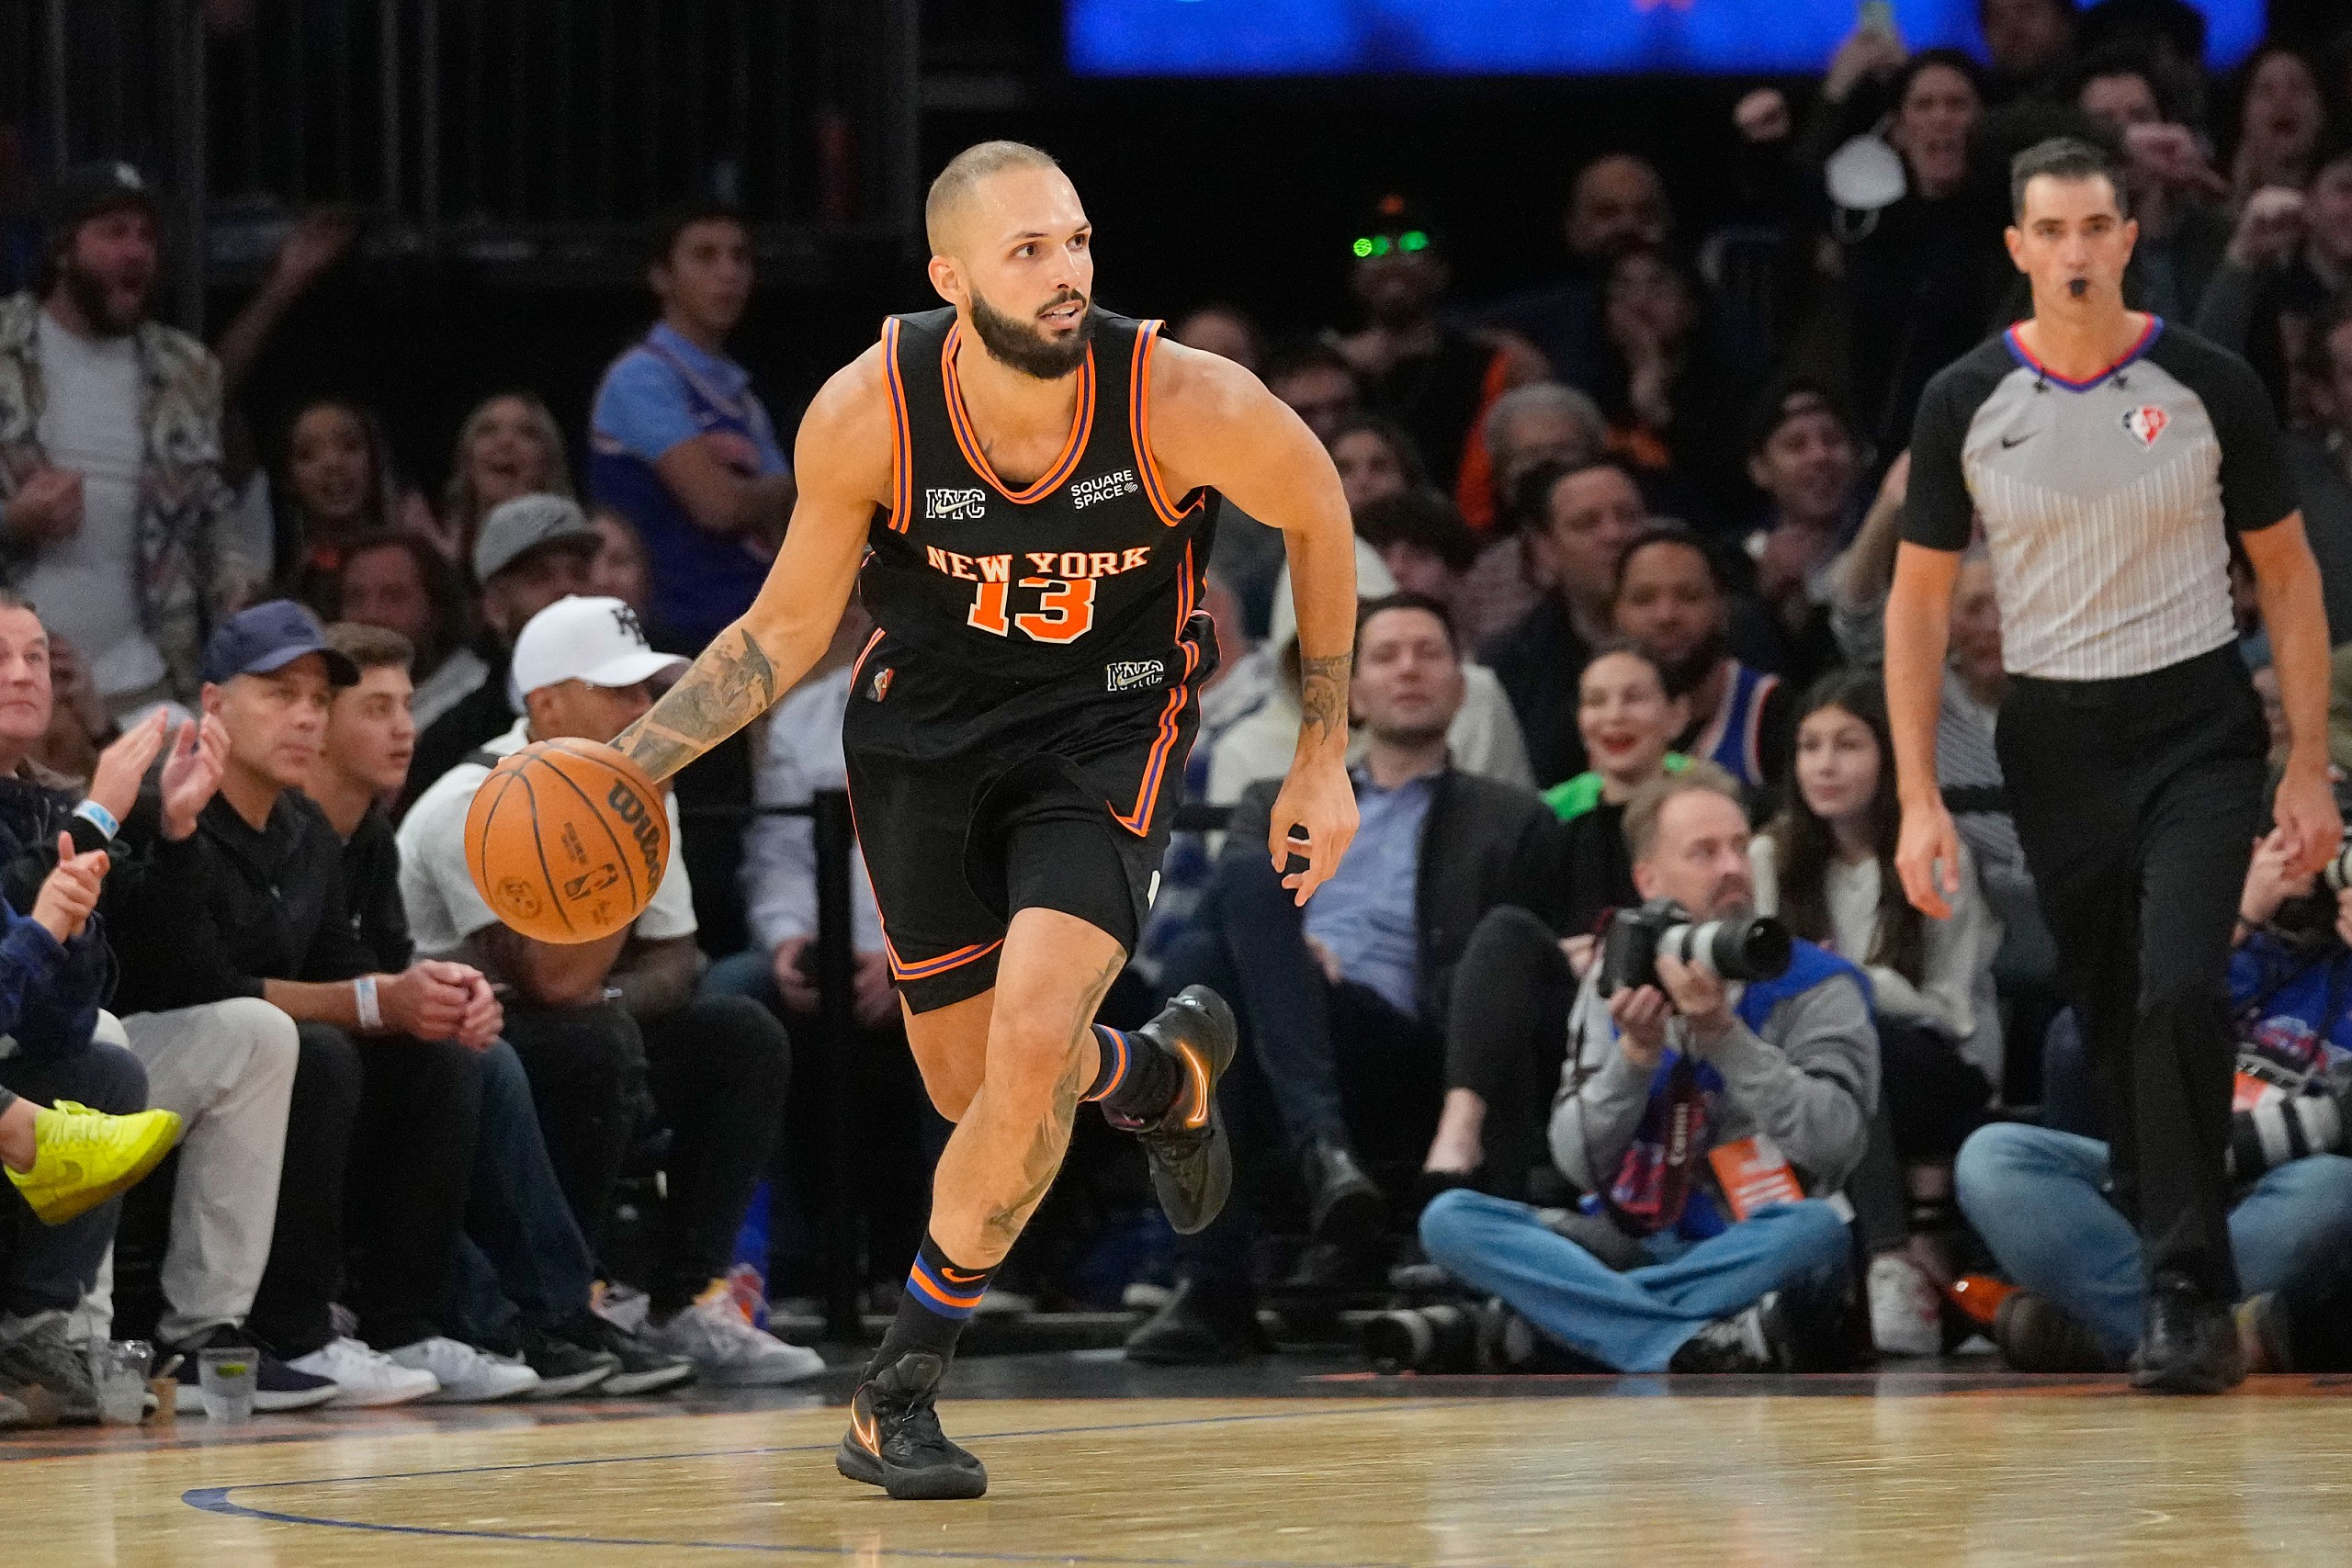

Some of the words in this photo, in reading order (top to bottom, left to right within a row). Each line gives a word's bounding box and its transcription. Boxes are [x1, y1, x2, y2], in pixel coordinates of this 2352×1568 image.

[1070, 469, 1134, 497] SQUARE
[1074, 487, 1125, 510] SPACE
[926, 489, 986, 520] NYC
[926, 546, 1012, 583] NEW
[1025, 547, 1151, 578] YORK
[967, 576, 1098, 644] 13
[1107, 660, 1164, 692] NYC
